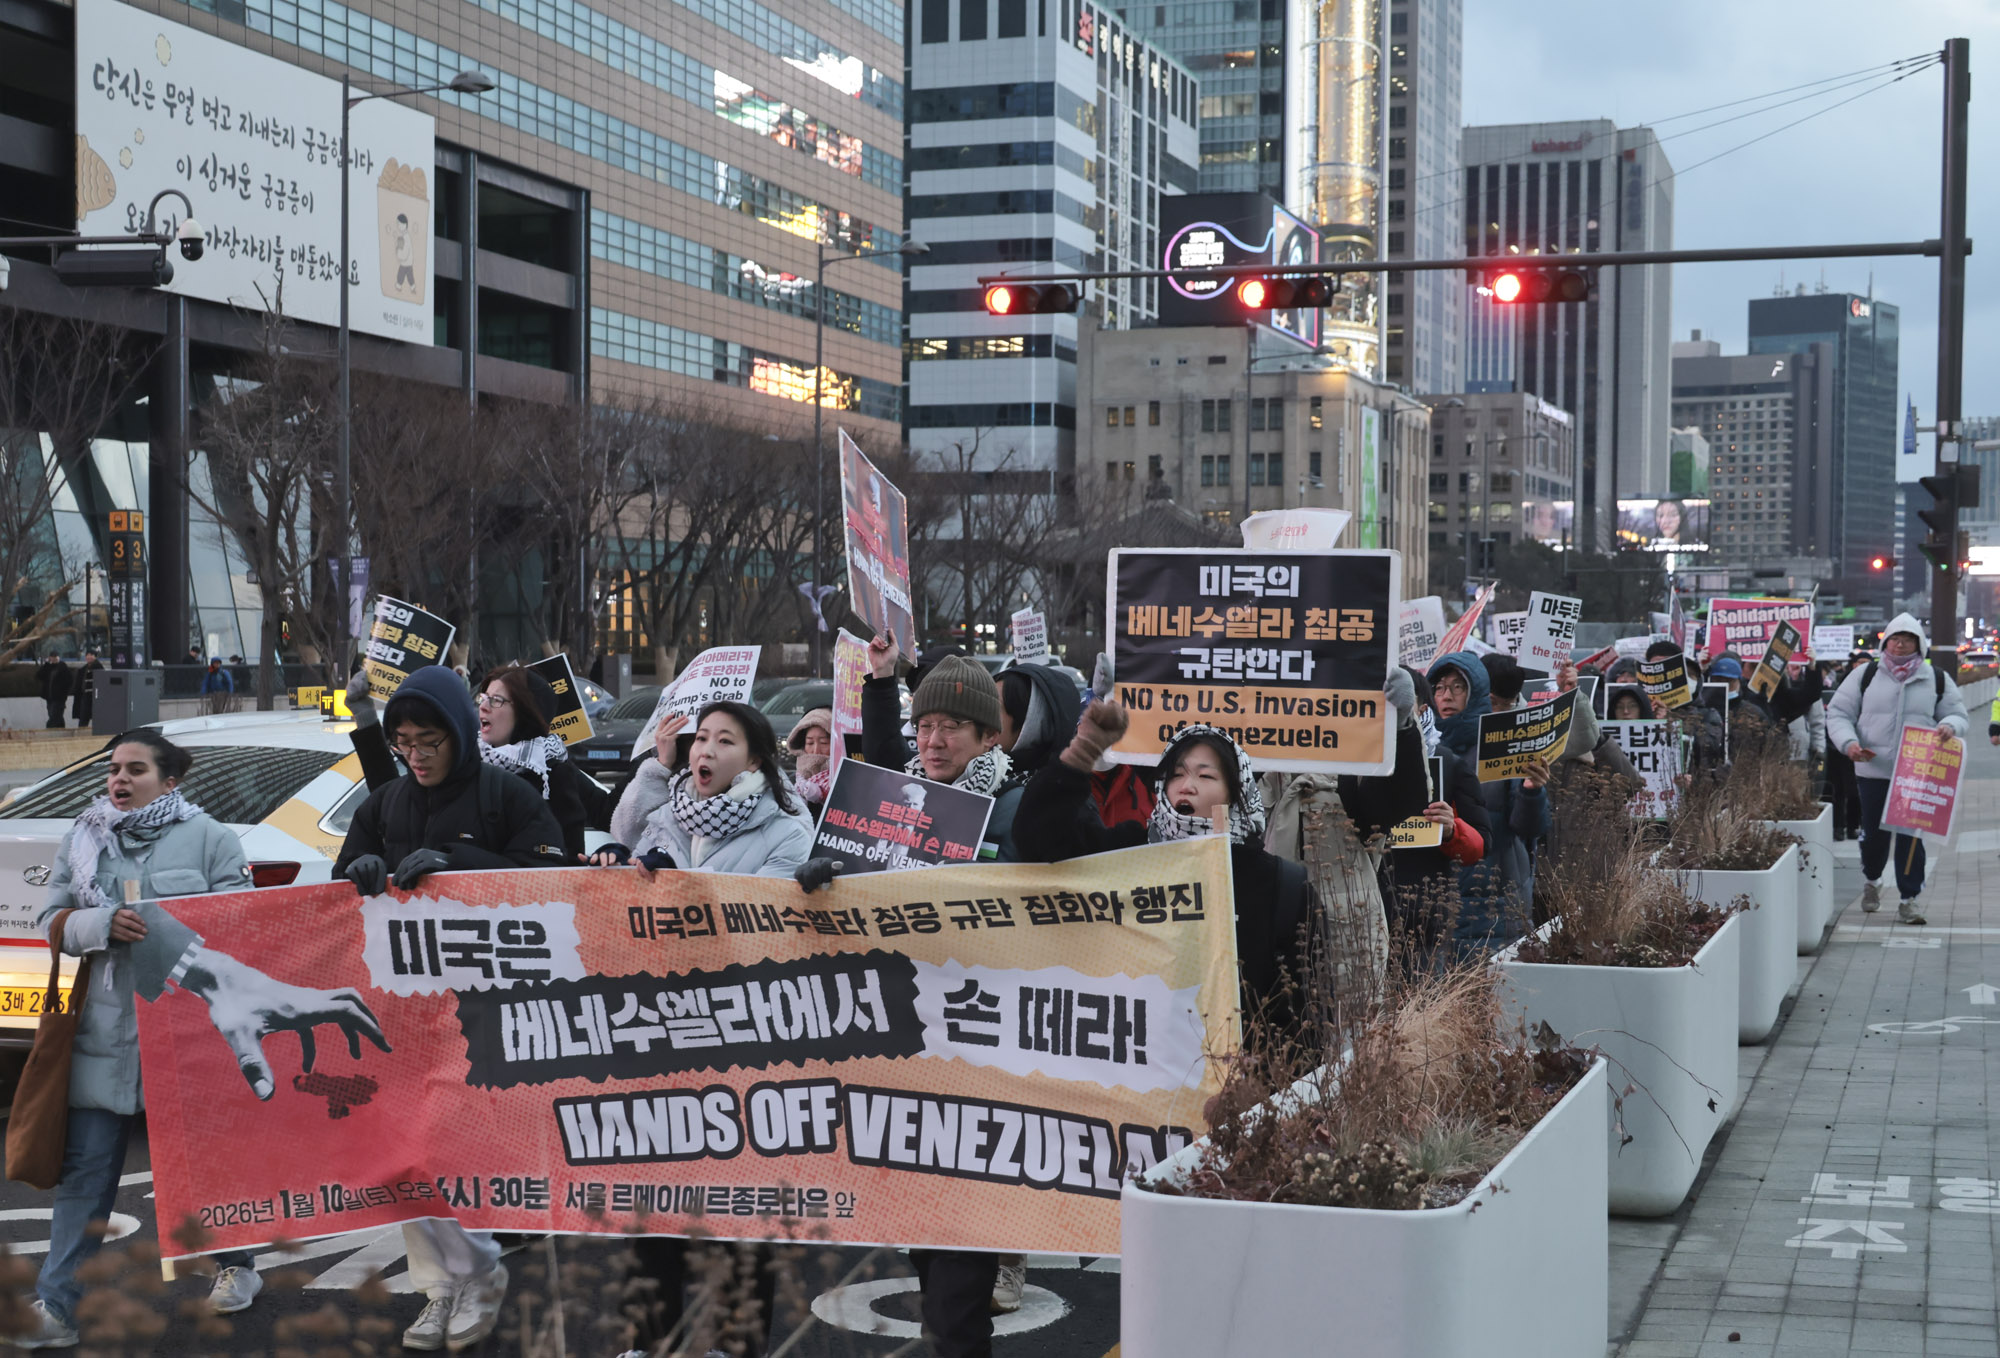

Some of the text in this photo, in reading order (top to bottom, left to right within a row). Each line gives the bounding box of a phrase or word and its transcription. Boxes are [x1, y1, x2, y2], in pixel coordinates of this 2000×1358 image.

[93, 57, 156, 111] 당신은
[162, 82, 195, 126] 무얼
[202, 96, 232, 131] 먹고
[239, 111, 295, 150] 지내는지
[177, 152, 314, 215] 이 싱거운 궁금증이
[205, 224, 285, 272] 가장자리를
[114, 539, 125, 559] 3
[133, 540, 141, 559] 3
[1199, 565, 1300, 598] 미국의
[1127, 605, 1375, 641] 베네수엘라 침공
[1712, 605, 1810, 626] ¡Solidaridad
[403, 633, 439, 660] 침공
[1028, 642, 1045, 650] Grab
[1725, 625, 1763, 640] para
[1017, 650, 1045, 660] America
[1178, 647, 1316, 681] 규탄한다
[1532, 645, 1551, 658] the
[701, 664, 750, 677] 중단하라
[709, 677, 747, 688] NO to
[712, 691, 744, 701] Grab
[1121, 687, 1153, 711] NO
[1161, 689, 1189, 713] to
[1255, 691, 1376, 718] invasion
[1484, 706, 1571, 743] 베네수엘라 침공
[1516, 704, 1554, 725] 미국의
[1507, 730, 1557, 754] 규탄한다
[1485, 760, 1501, 769] NO
[1504, 757, 1514, 766] to
[1516, 754, 1538, 763] U.S.
[1502, 766, 1512, 776] of
[876, 800, 933, 830] 트럼프는
[817, 831, 865, 857] HANDS
[865, 845, 890, 864] OFF
[824, 807, 974, 861] 베네수엘라에서 손 떼라
[627, 882, 1206, 941] 미국의 베네수엘라 침공 규탄 집회와 행진
[387, 918, 552, 981] 미국은
[500, 968, 1148, 1066] 베네수엘라에서 손 떼라!
[558, 1090, 744, 1162] HANDS
[751, 1084, 838, 1152] OFF
[199, 1198, 275, 1230] 2026년
[279, 1189, 315, 1219] 1월
[319, 1183, 396, 1214] 10일(토)
[396, 1180, 437, 1202] 오후
[488, 1176, 551, 1211] 30분
[565, 1181, 607, 1214] 서울
[611, 1182, 829, 1219] 르메이에르종로타운
[834, 1191, 857, 1219] 앞
